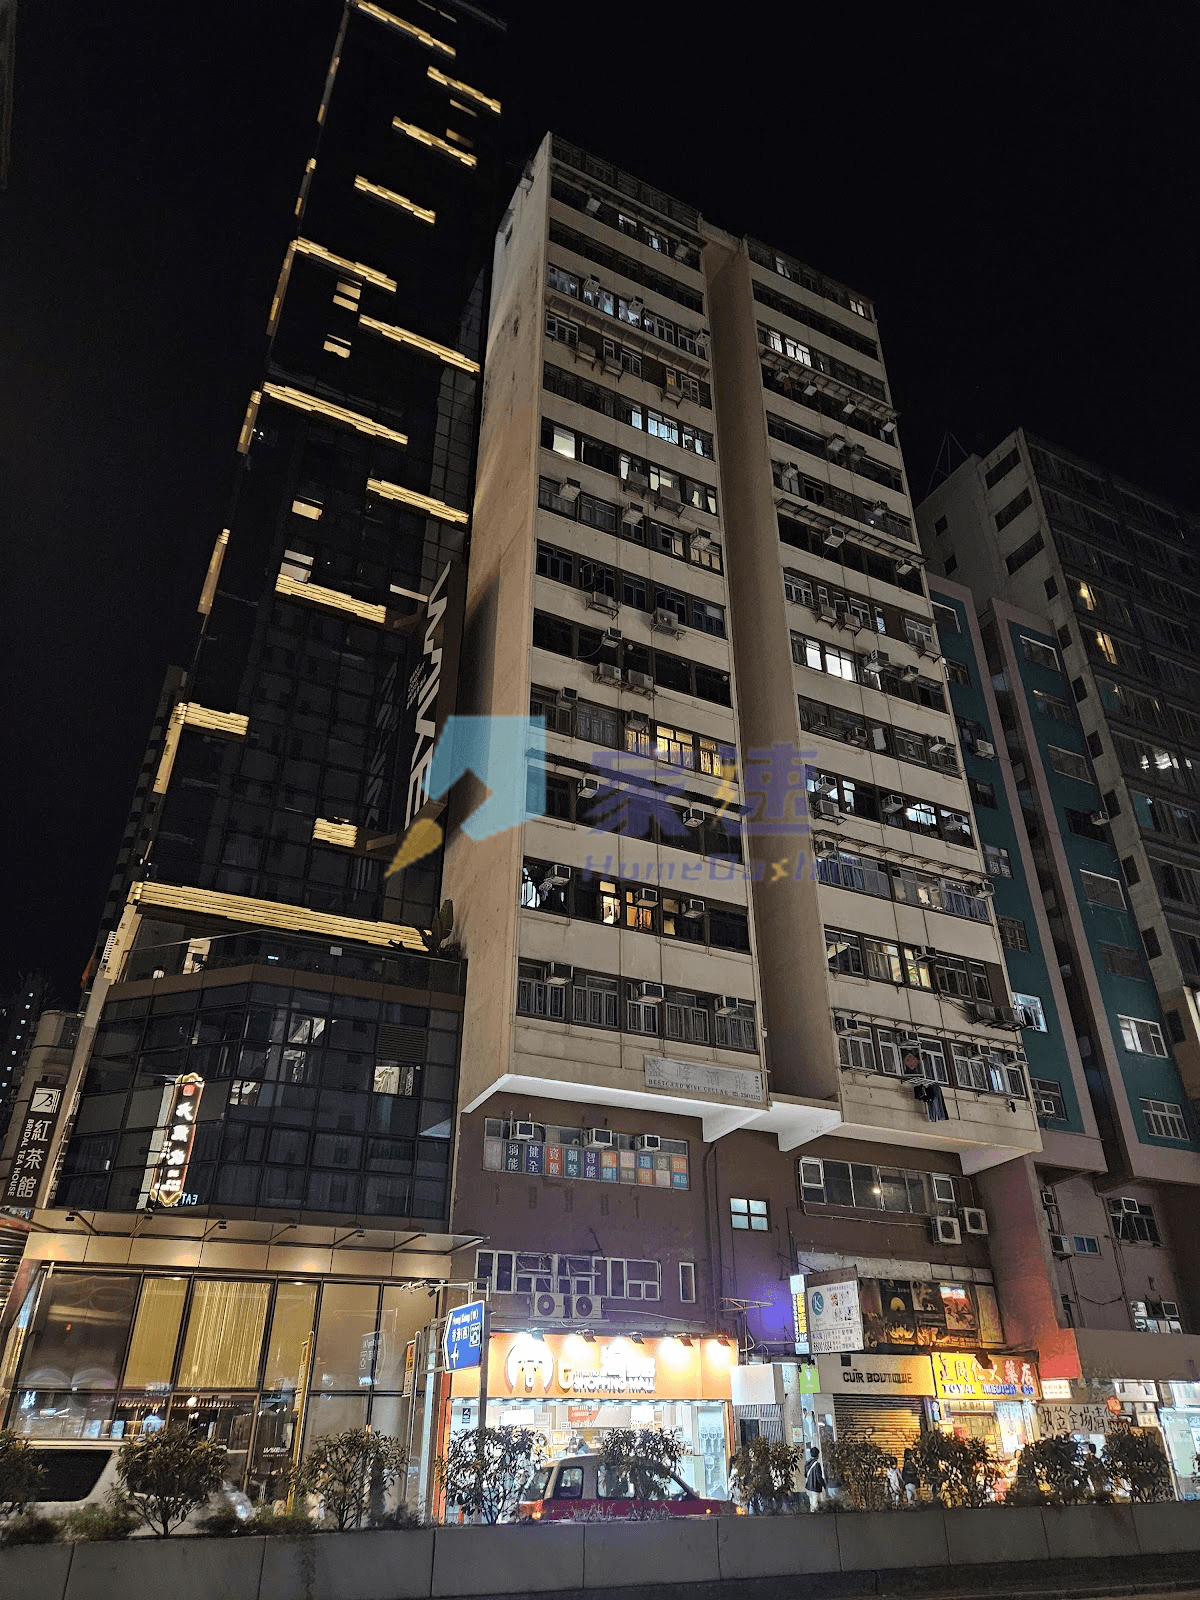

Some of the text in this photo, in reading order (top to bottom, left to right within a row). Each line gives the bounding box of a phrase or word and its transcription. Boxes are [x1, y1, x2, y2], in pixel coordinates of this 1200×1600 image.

[7, 1118, 35, 1197] BRIDAL TEA HOUSE
[16, 1119, 52, 1198] 紅茶館
[507, 1143, 519, 1171] 弱能
[528, 1145, 540, 1173] 健全
[586, 1151, 596, 1178] 智能
